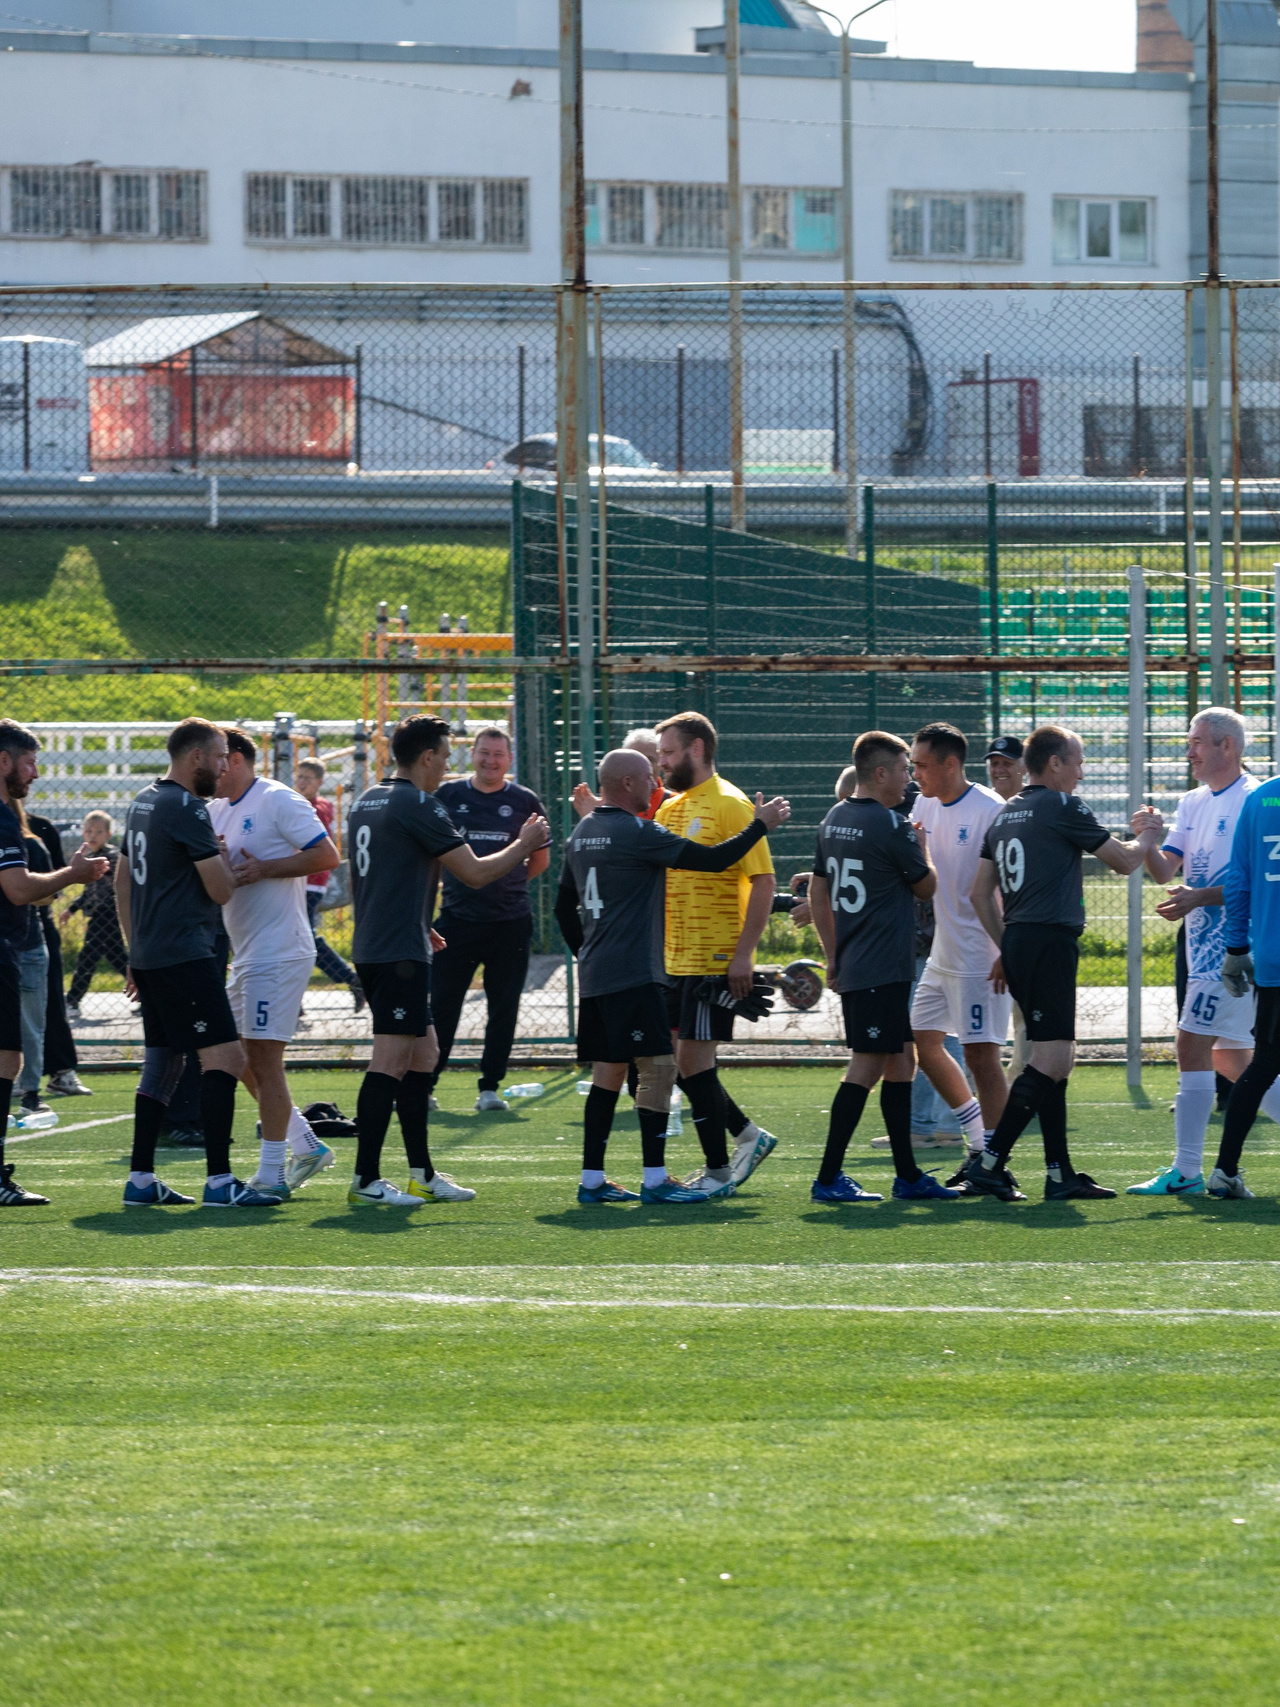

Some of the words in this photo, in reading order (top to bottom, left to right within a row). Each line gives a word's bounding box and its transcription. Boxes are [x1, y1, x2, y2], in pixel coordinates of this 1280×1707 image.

[127, 829, 147, 886] 13
[356, 825, 371, 877] 8
[995, 837, 1026, 894] 19
[584, 866, 604, 919] 4
[826, 856, 867, 914] 25
[256, 1000, 269, 1027] 5
[971, 1003, 982, 1030] 9
[1191, 992, 1220, 1022] 45
